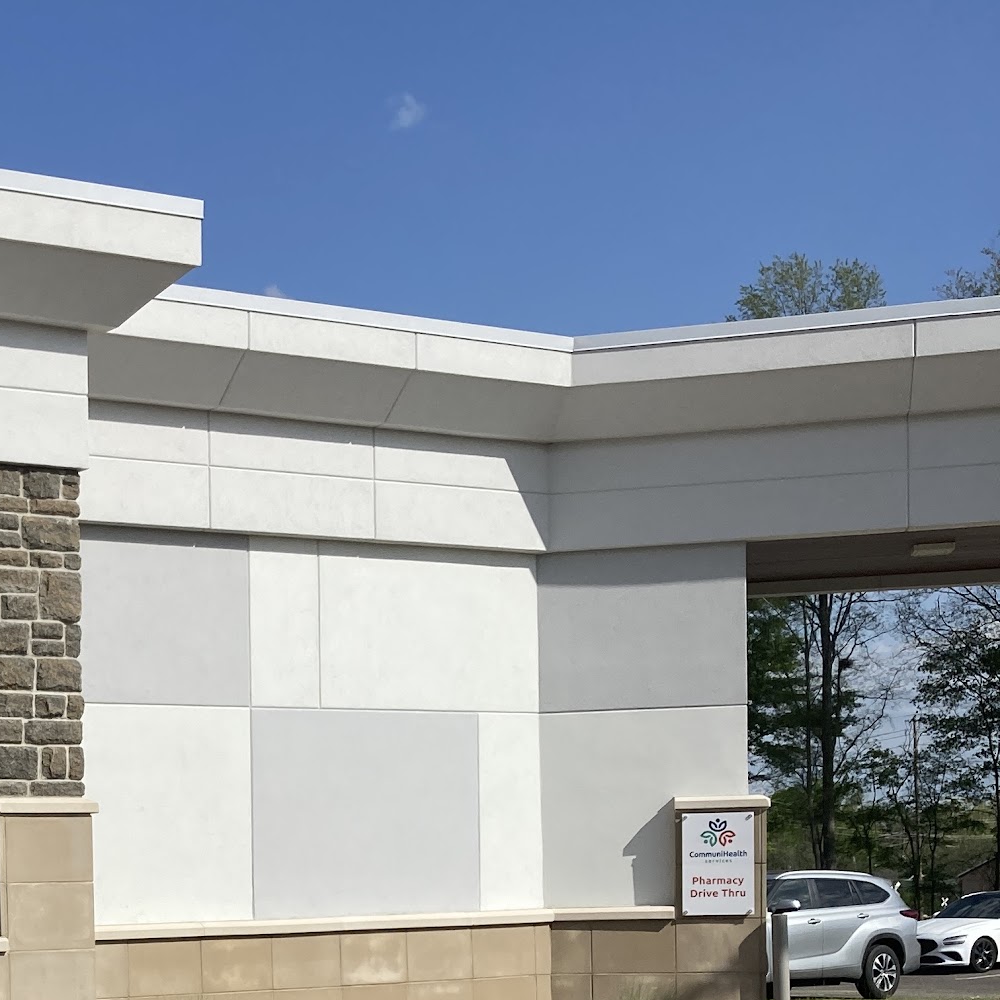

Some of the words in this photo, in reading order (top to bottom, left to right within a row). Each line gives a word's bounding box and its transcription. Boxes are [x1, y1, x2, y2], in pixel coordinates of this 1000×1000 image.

[689, 850, 747, 858] CommuniHealth
[692, 876, 744, 887] Pharmacy
[690, 889, 718, 898] Drive
[721, 889, 746, 898] Thru
